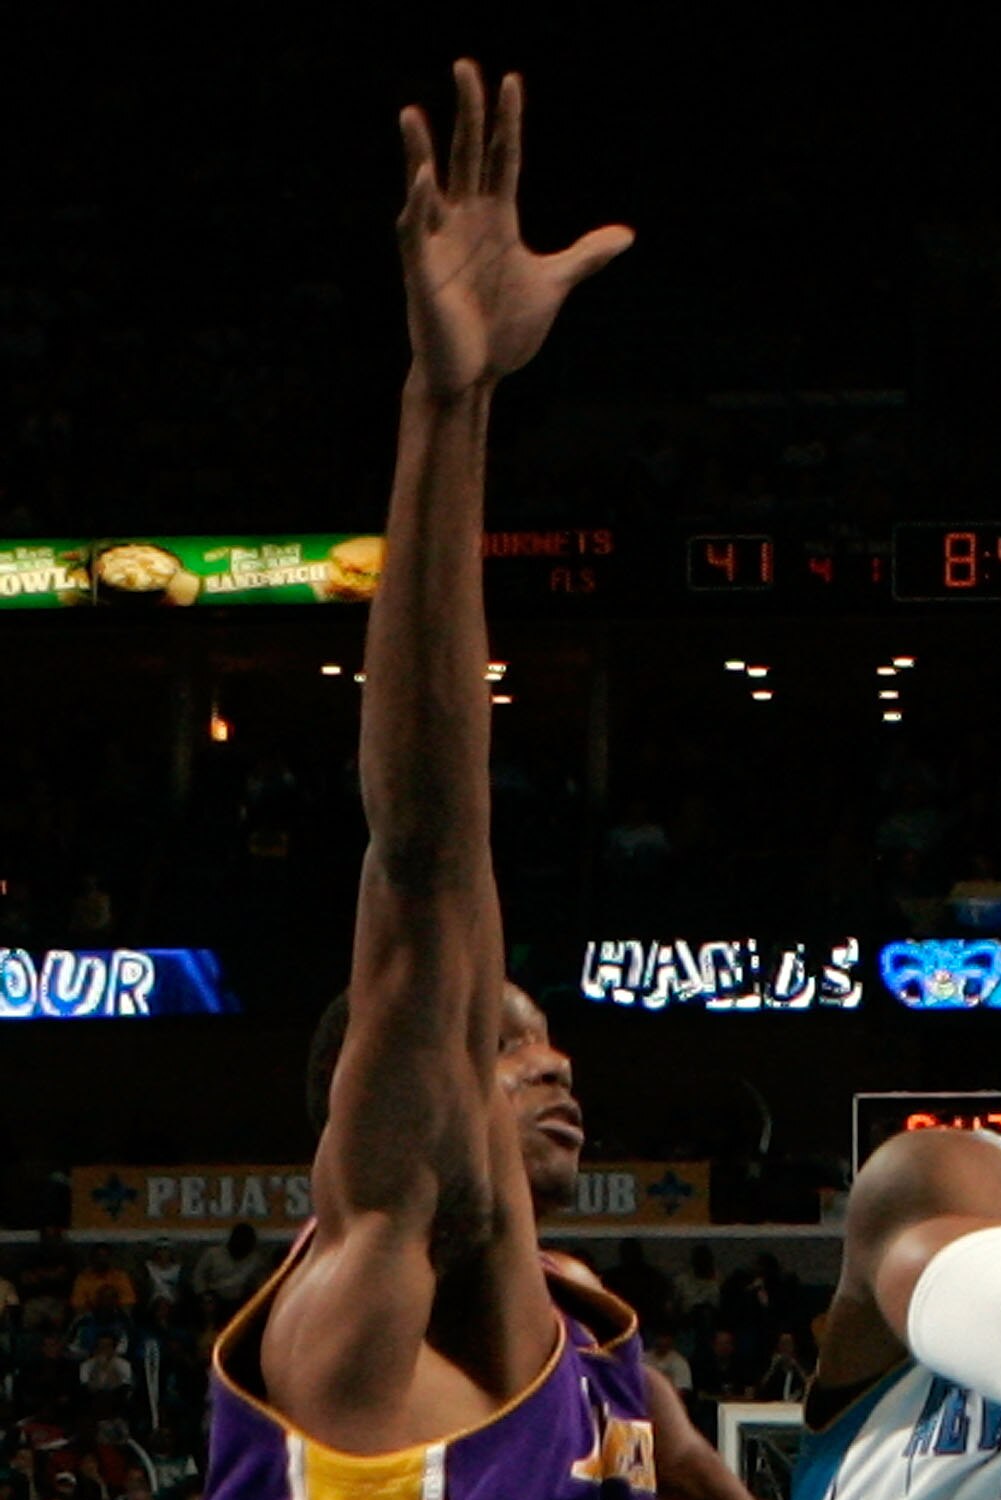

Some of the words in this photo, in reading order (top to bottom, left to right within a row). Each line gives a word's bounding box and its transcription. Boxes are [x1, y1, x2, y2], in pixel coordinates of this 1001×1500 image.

[704, 542, 774, 583] 41
[145, 1174, 312, 1219] PEJA'S
[565, 1172, 640, 1216] UB
